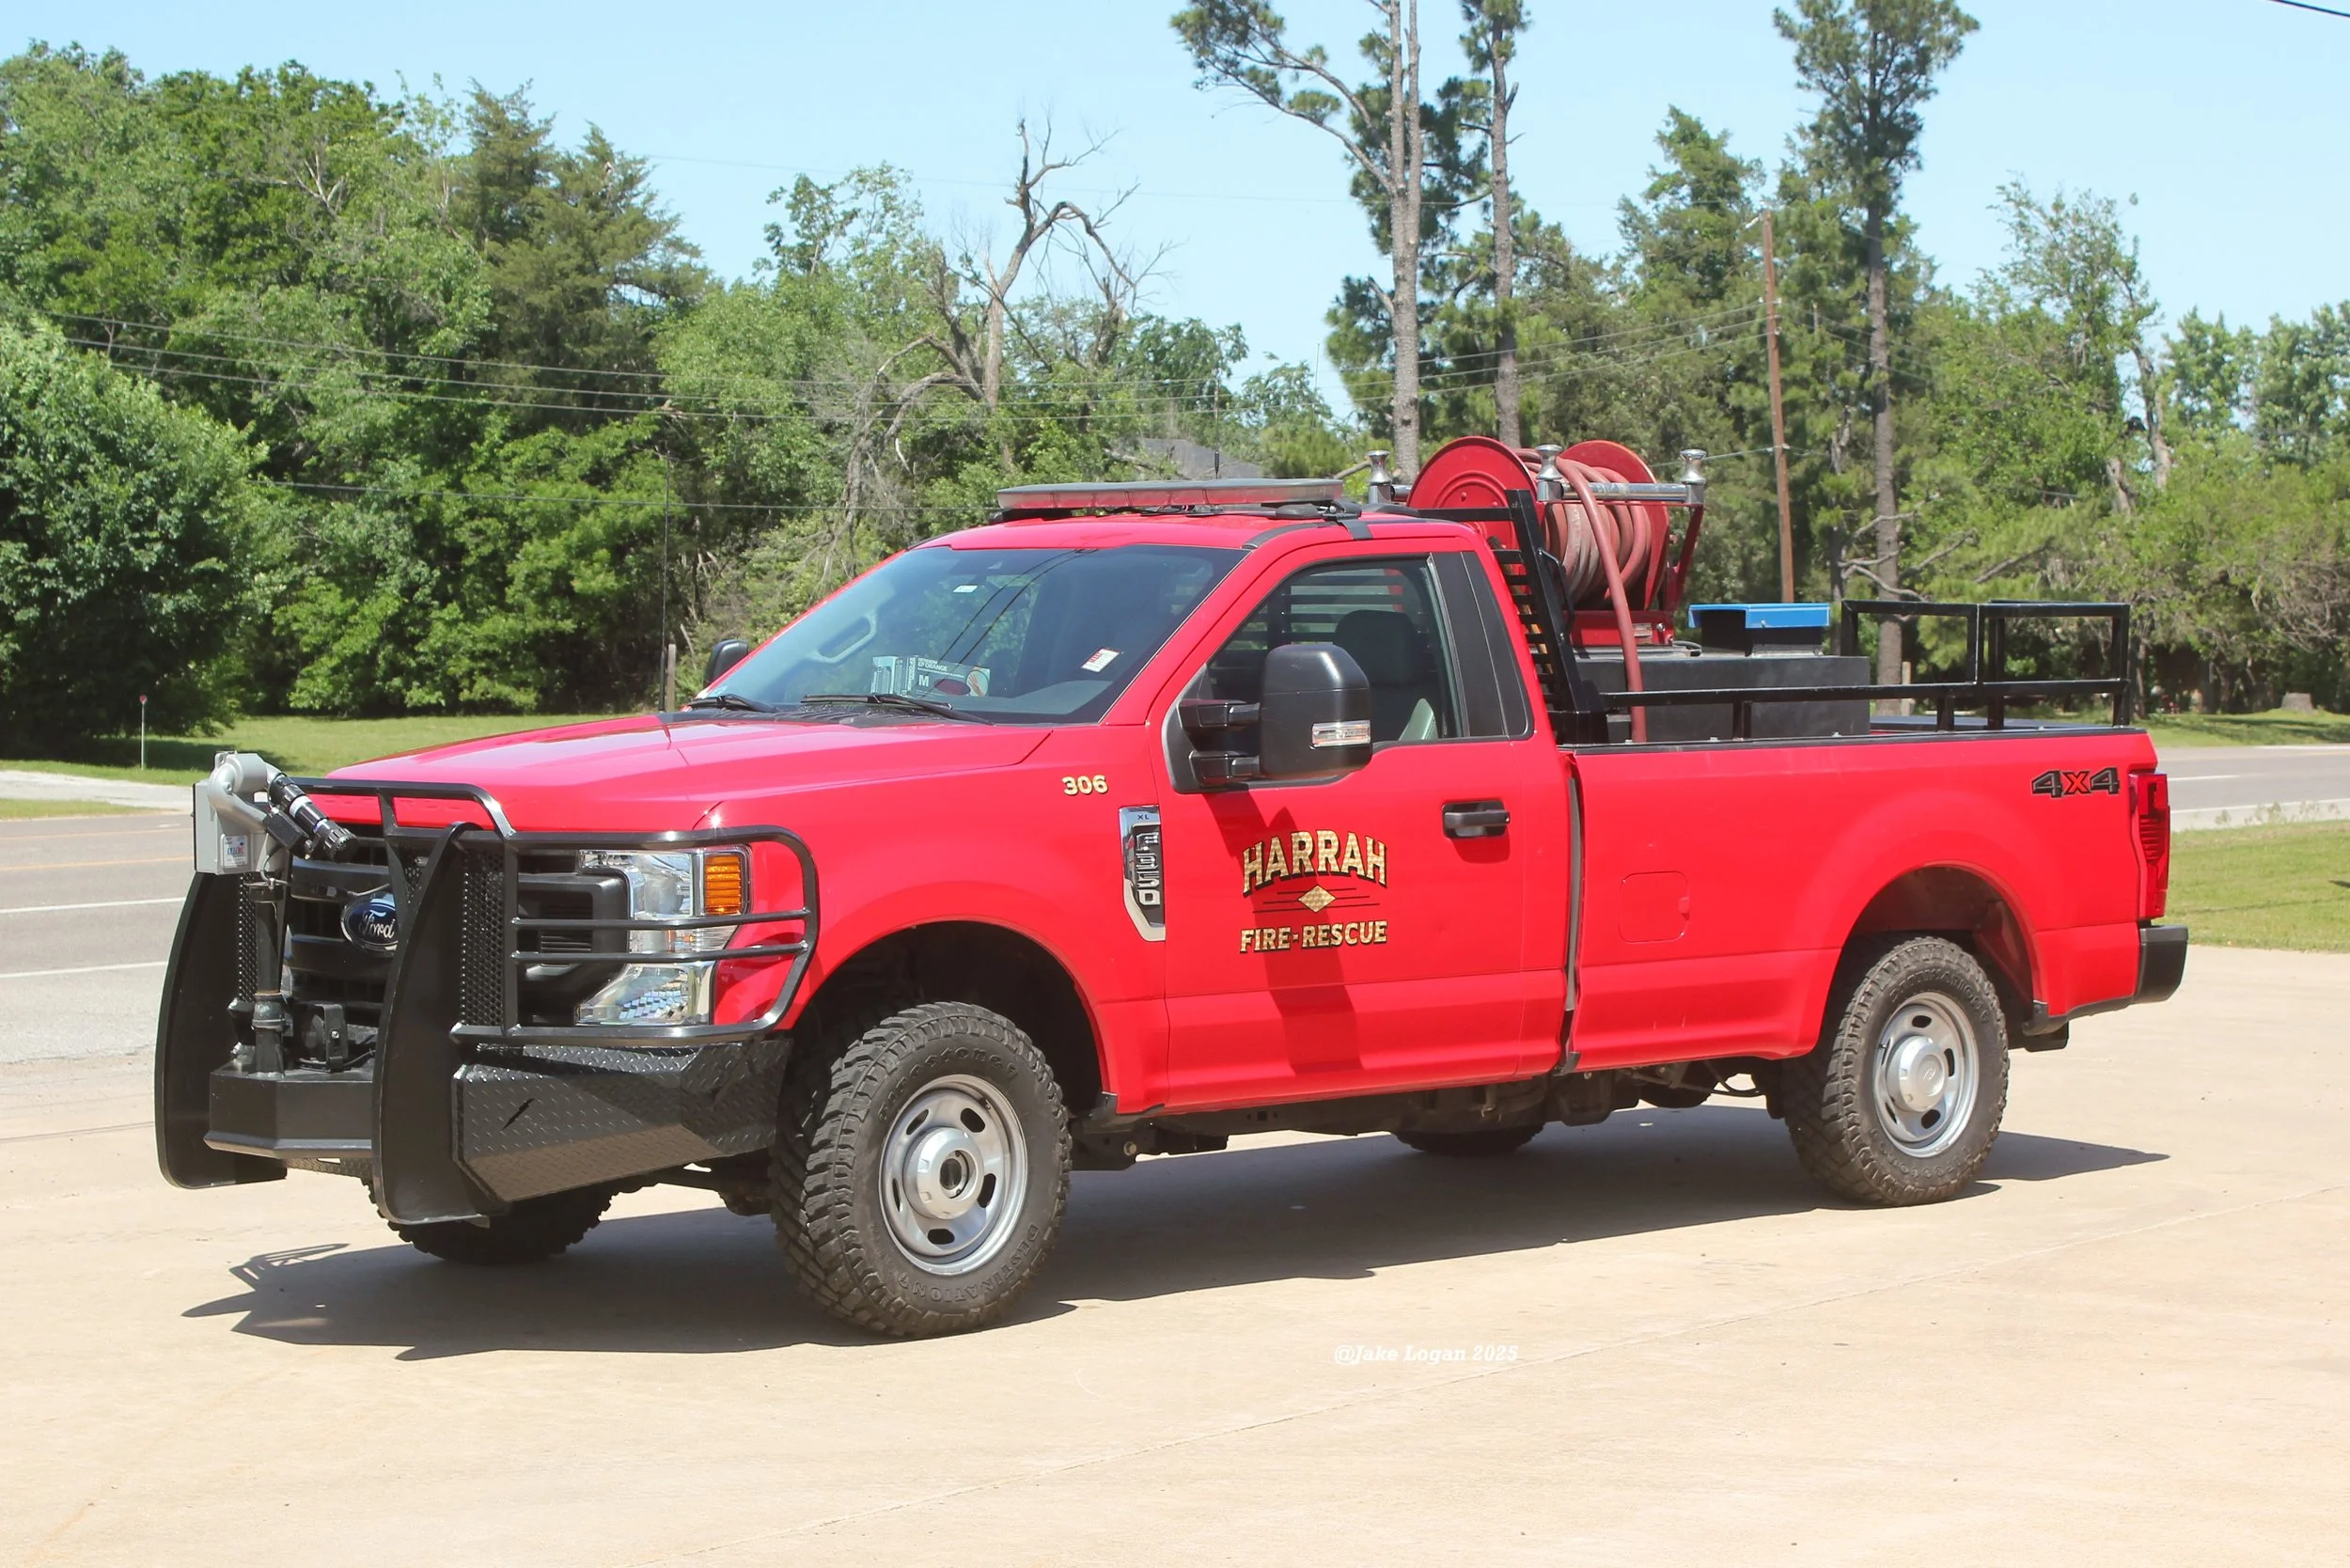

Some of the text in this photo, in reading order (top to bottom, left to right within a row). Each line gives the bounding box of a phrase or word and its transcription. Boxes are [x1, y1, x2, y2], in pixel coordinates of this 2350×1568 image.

[918, 674, 930, 687] M
[1061, 774, 1108, 795] 306
[1242, 829, 1387, 897] HARRAH
[358, 909, 396, 939] Ford
